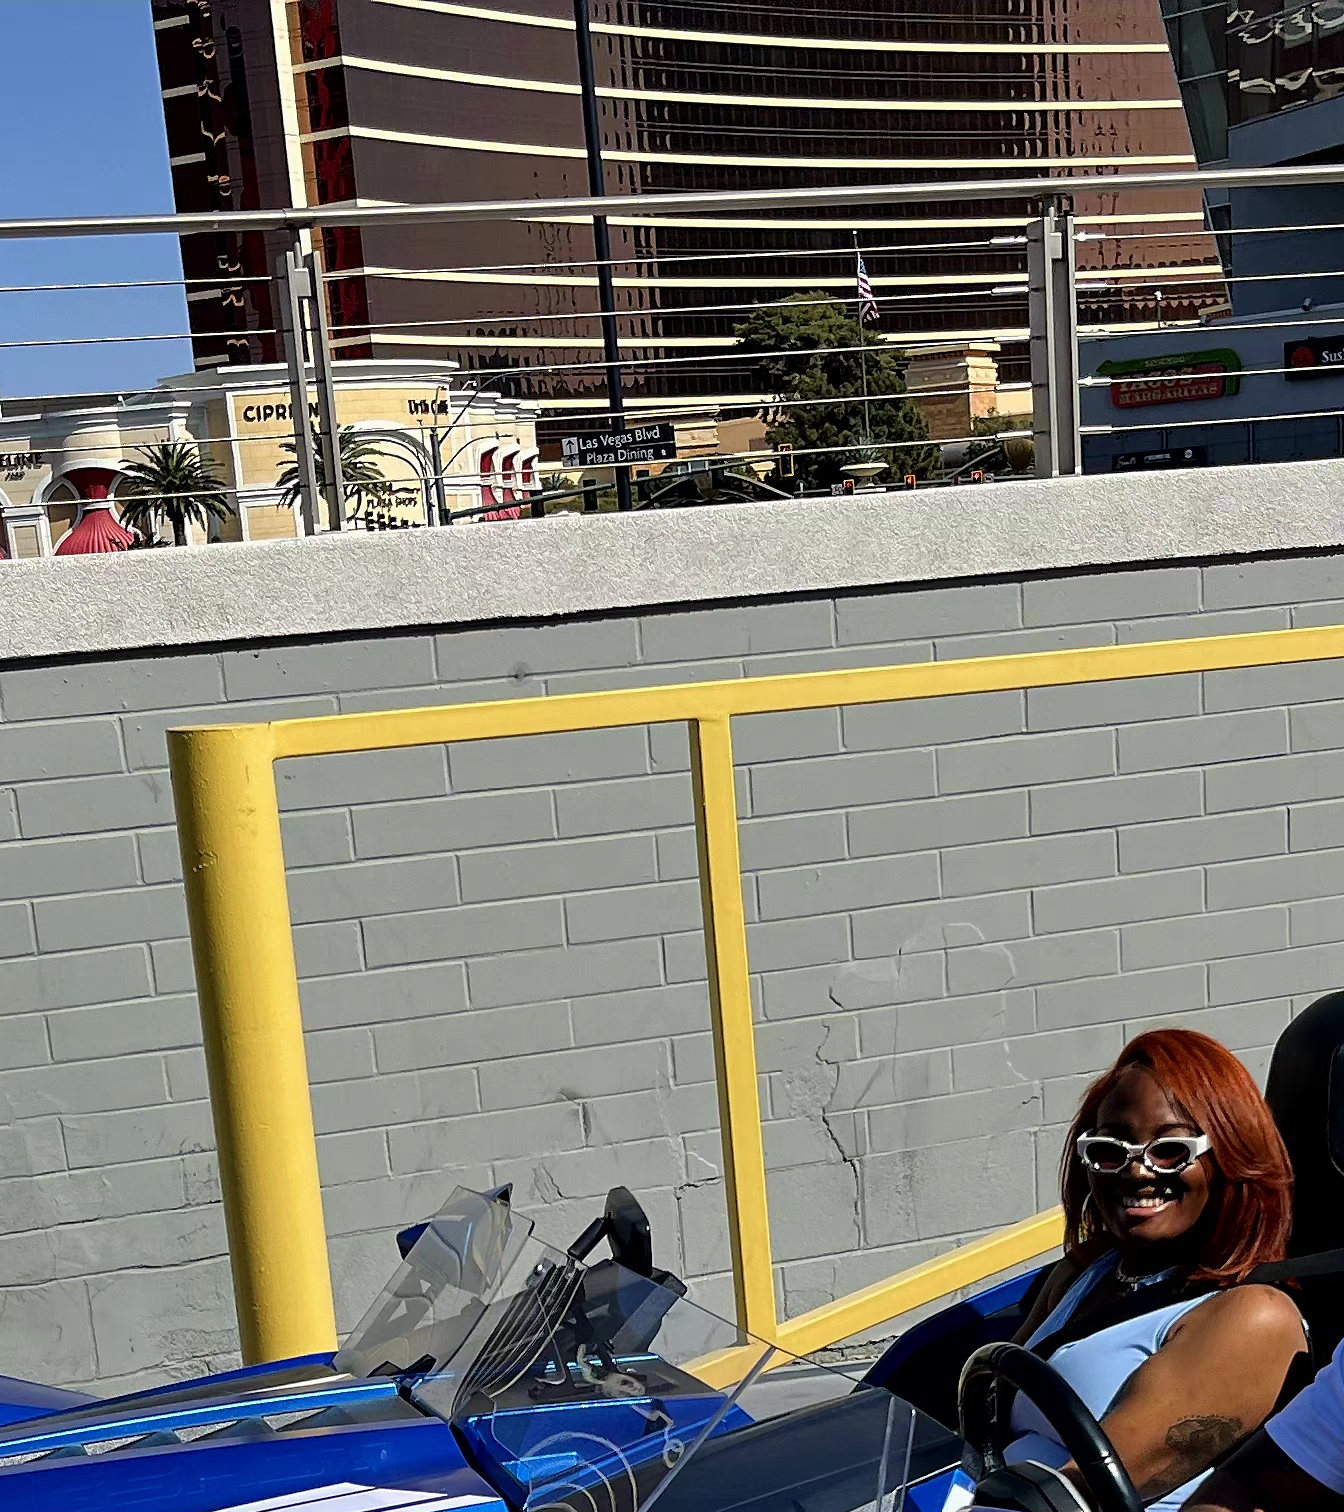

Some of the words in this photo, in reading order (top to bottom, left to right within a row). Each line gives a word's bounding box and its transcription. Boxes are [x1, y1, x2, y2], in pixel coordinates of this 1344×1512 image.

[579, 437, 599, 450] Las
[599, 432, 633, 448] Vegas
[634, 425, 661, 442] Blvd
[586, 451, 615, 465] Plaza
[617, 448, 655, 461] Dining
